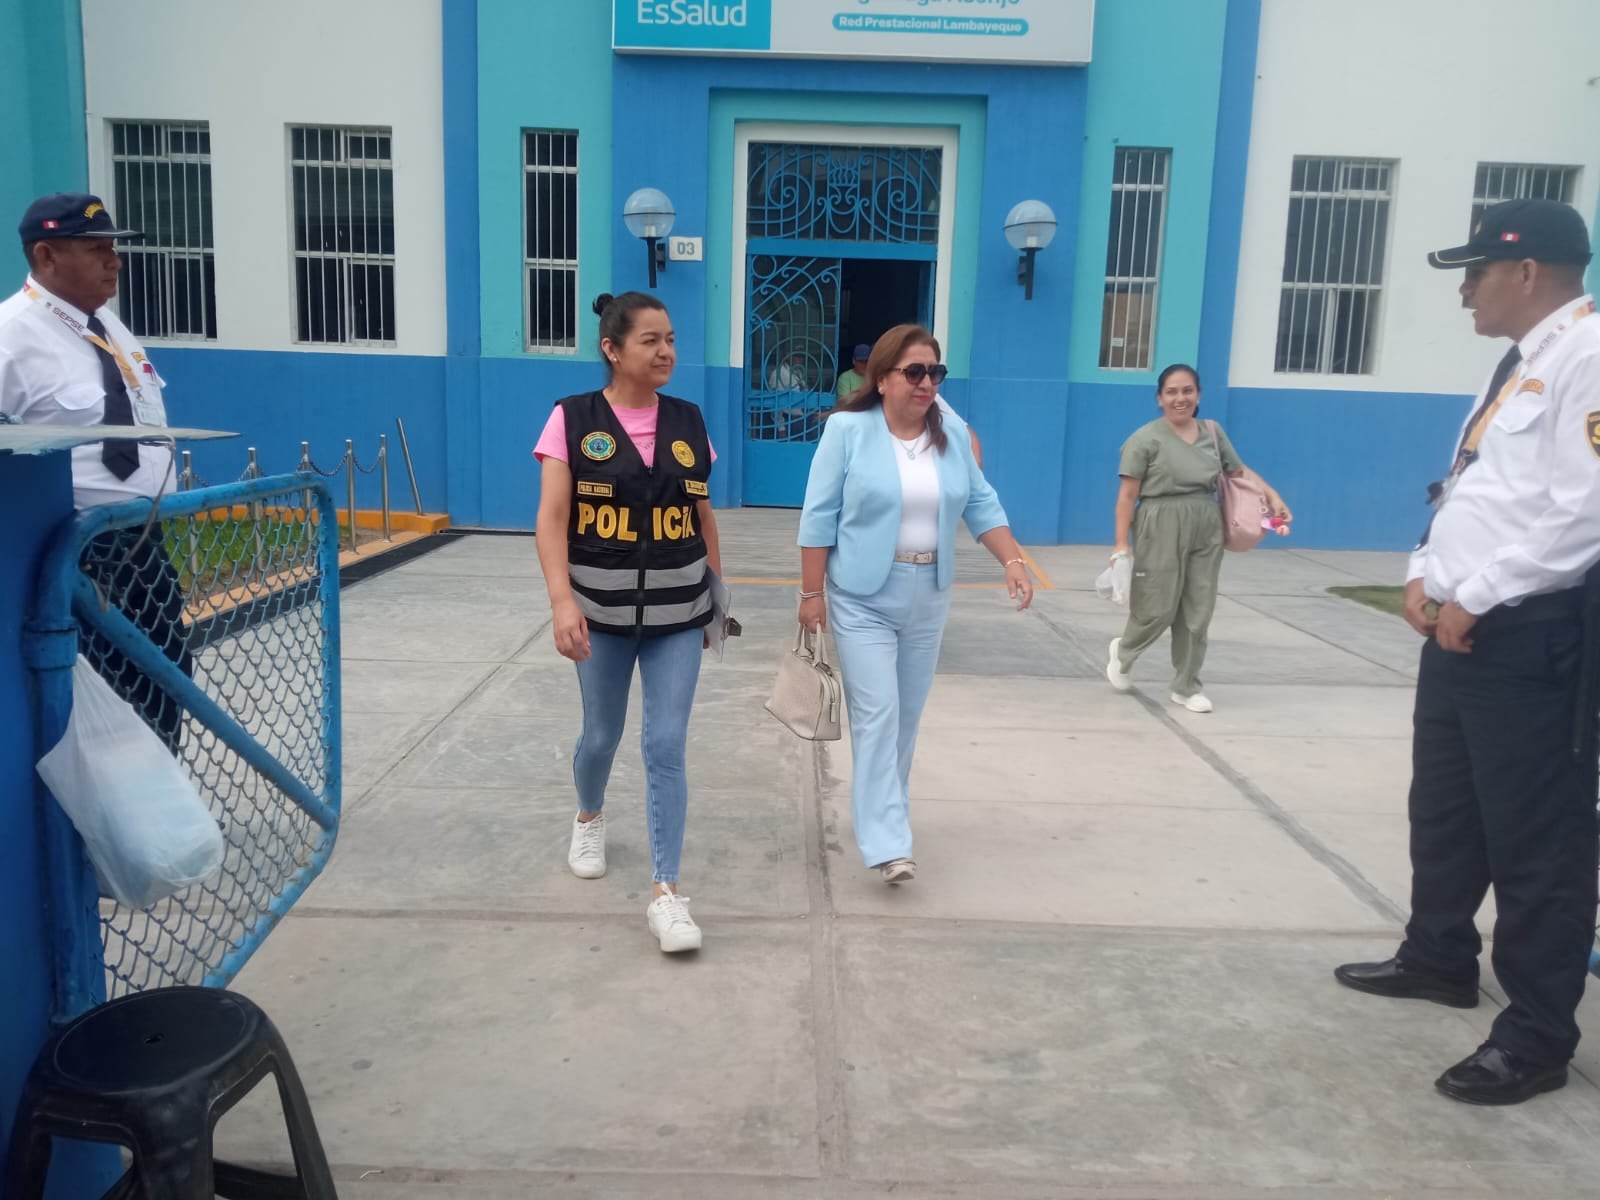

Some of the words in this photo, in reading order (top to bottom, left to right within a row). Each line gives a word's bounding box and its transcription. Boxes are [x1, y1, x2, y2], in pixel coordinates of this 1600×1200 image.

[637, 0, 748, 27] EsSalud
[839, 16, 864, 27] Red
[864, 17, 941, 30] Prestacional
[943, 19, 1022, 34] Lambayeque
[677, 241, 695, 255] 03
